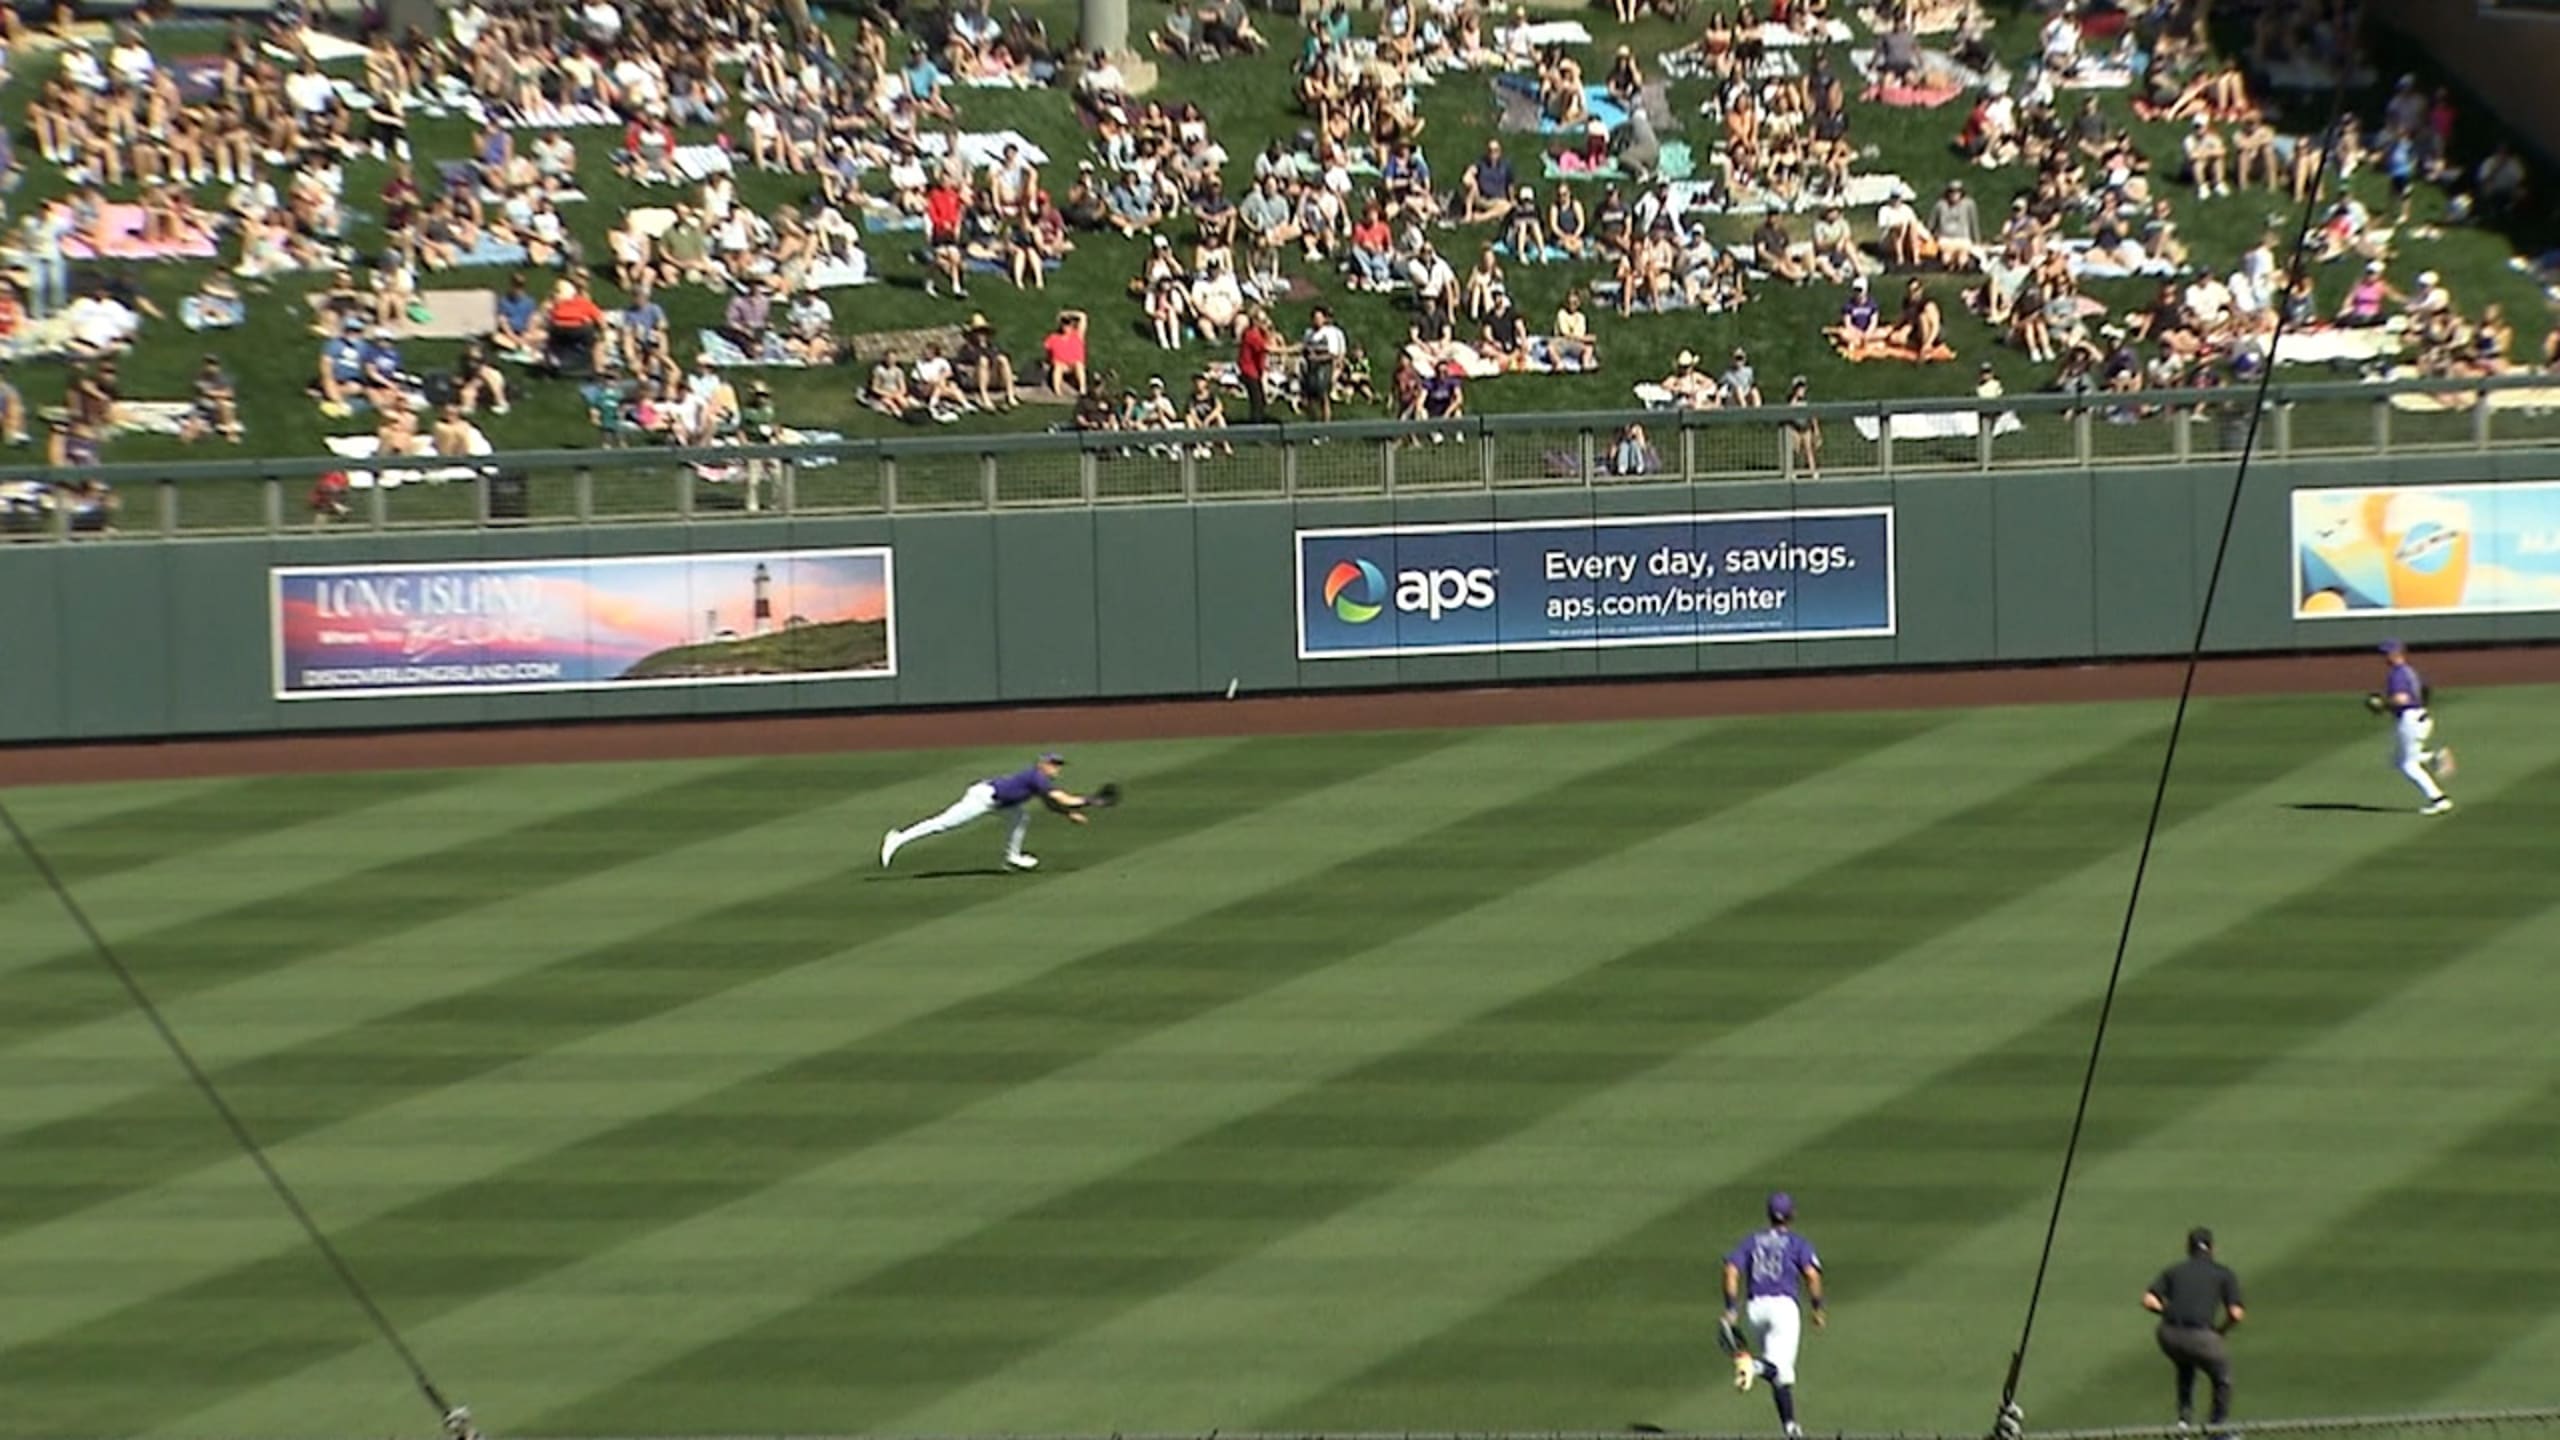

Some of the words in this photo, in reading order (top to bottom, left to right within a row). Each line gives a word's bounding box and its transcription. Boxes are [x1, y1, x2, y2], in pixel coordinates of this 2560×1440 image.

[1545, 551, 1637, 582] Every
[1648, 547, 1715, 580] day,
[1724, 541, 1856, 575] savings.
[316, 578, 411, 619] LONG
[421, 574, 543, 616] ISLAND
[1396, 568, 1496, 620] aps
[1546, 585, 1787, 621] aps.com/brighter
